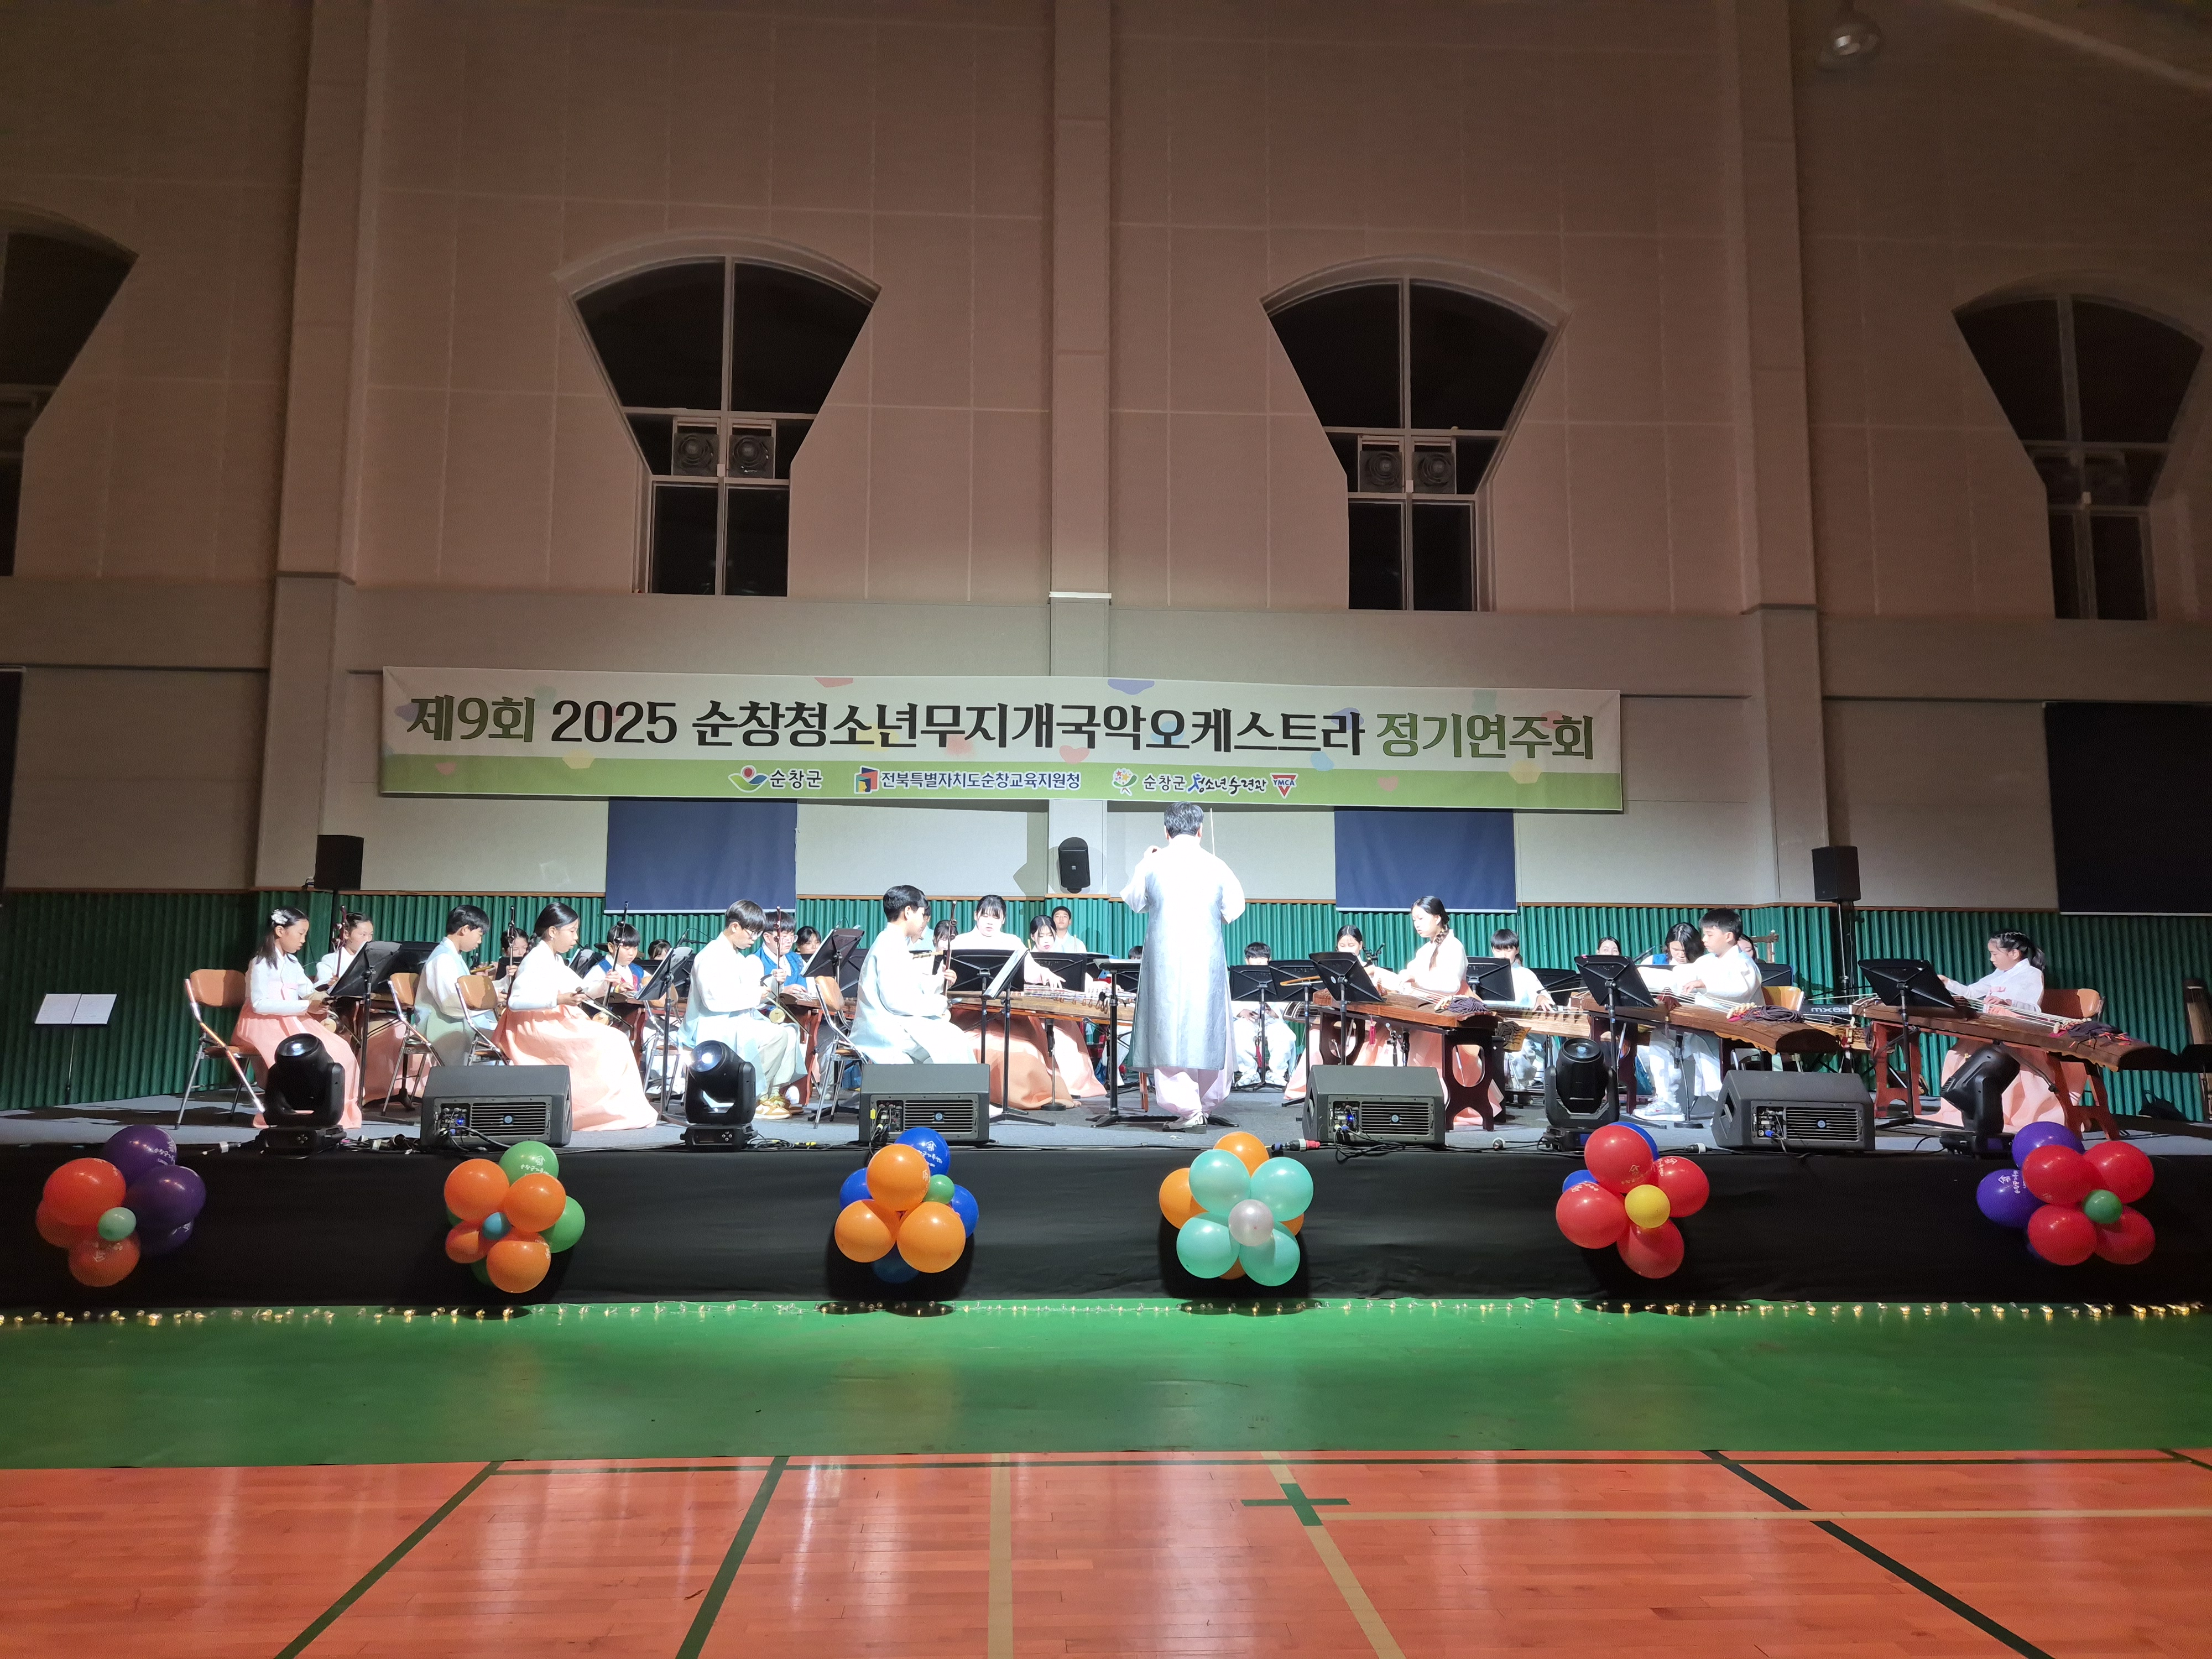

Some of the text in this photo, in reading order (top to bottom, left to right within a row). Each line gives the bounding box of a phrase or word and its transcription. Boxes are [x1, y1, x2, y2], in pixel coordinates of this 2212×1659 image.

[406, 693, 1593, 760] 제9회 2025 순창청소년무지개국악오케스트라 정기연주회
[770, 769, 822, 789] 순창군
[881, 772, 1080, 789] 전북특별자치도순창교육지원청
[1143, 774, 1267, 795] 순창군 청소년수련관
